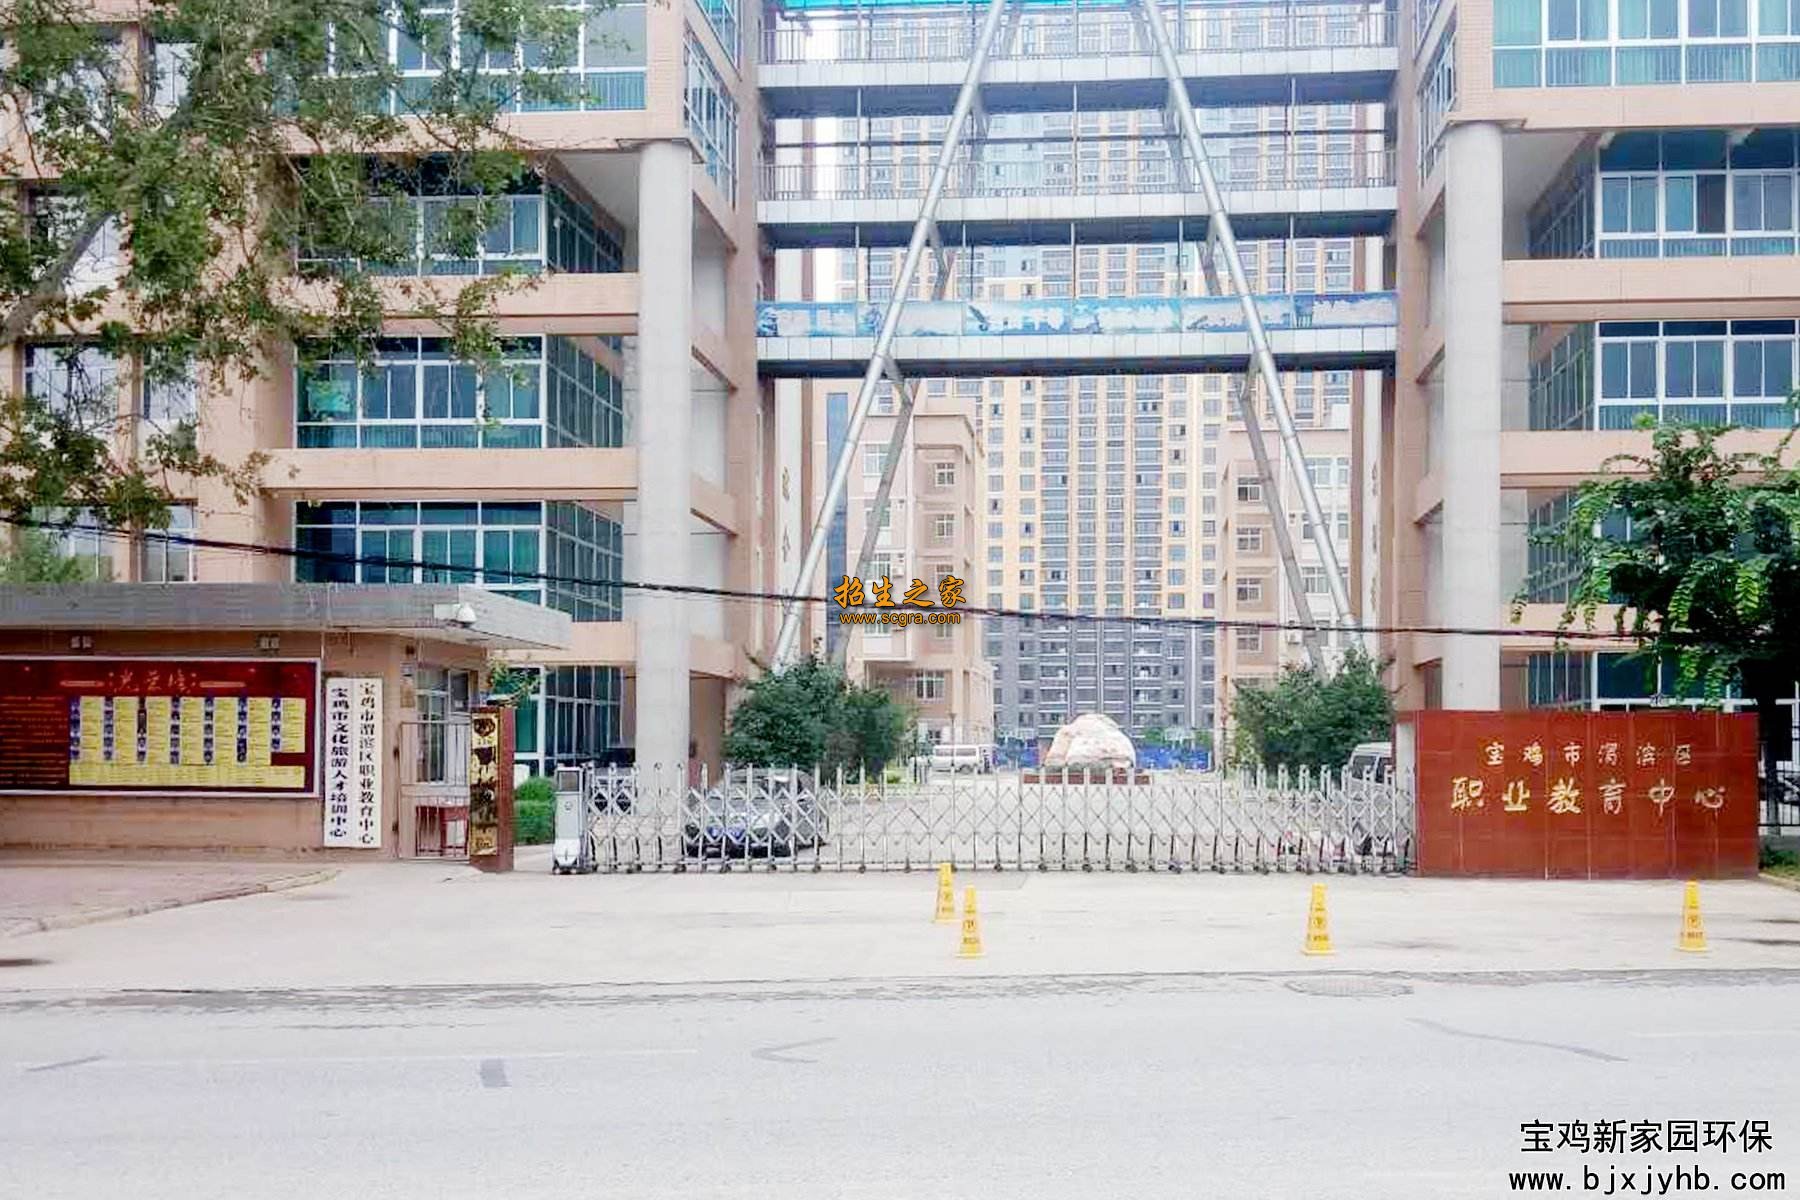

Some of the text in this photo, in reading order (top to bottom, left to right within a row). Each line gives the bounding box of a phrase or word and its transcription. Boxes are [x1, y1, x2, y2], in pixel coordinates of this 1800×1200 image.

[1484, 741, 1692, 767] 宝鸡市渭滨区
[1450, 776, 1726, 818] 职业教育中心
